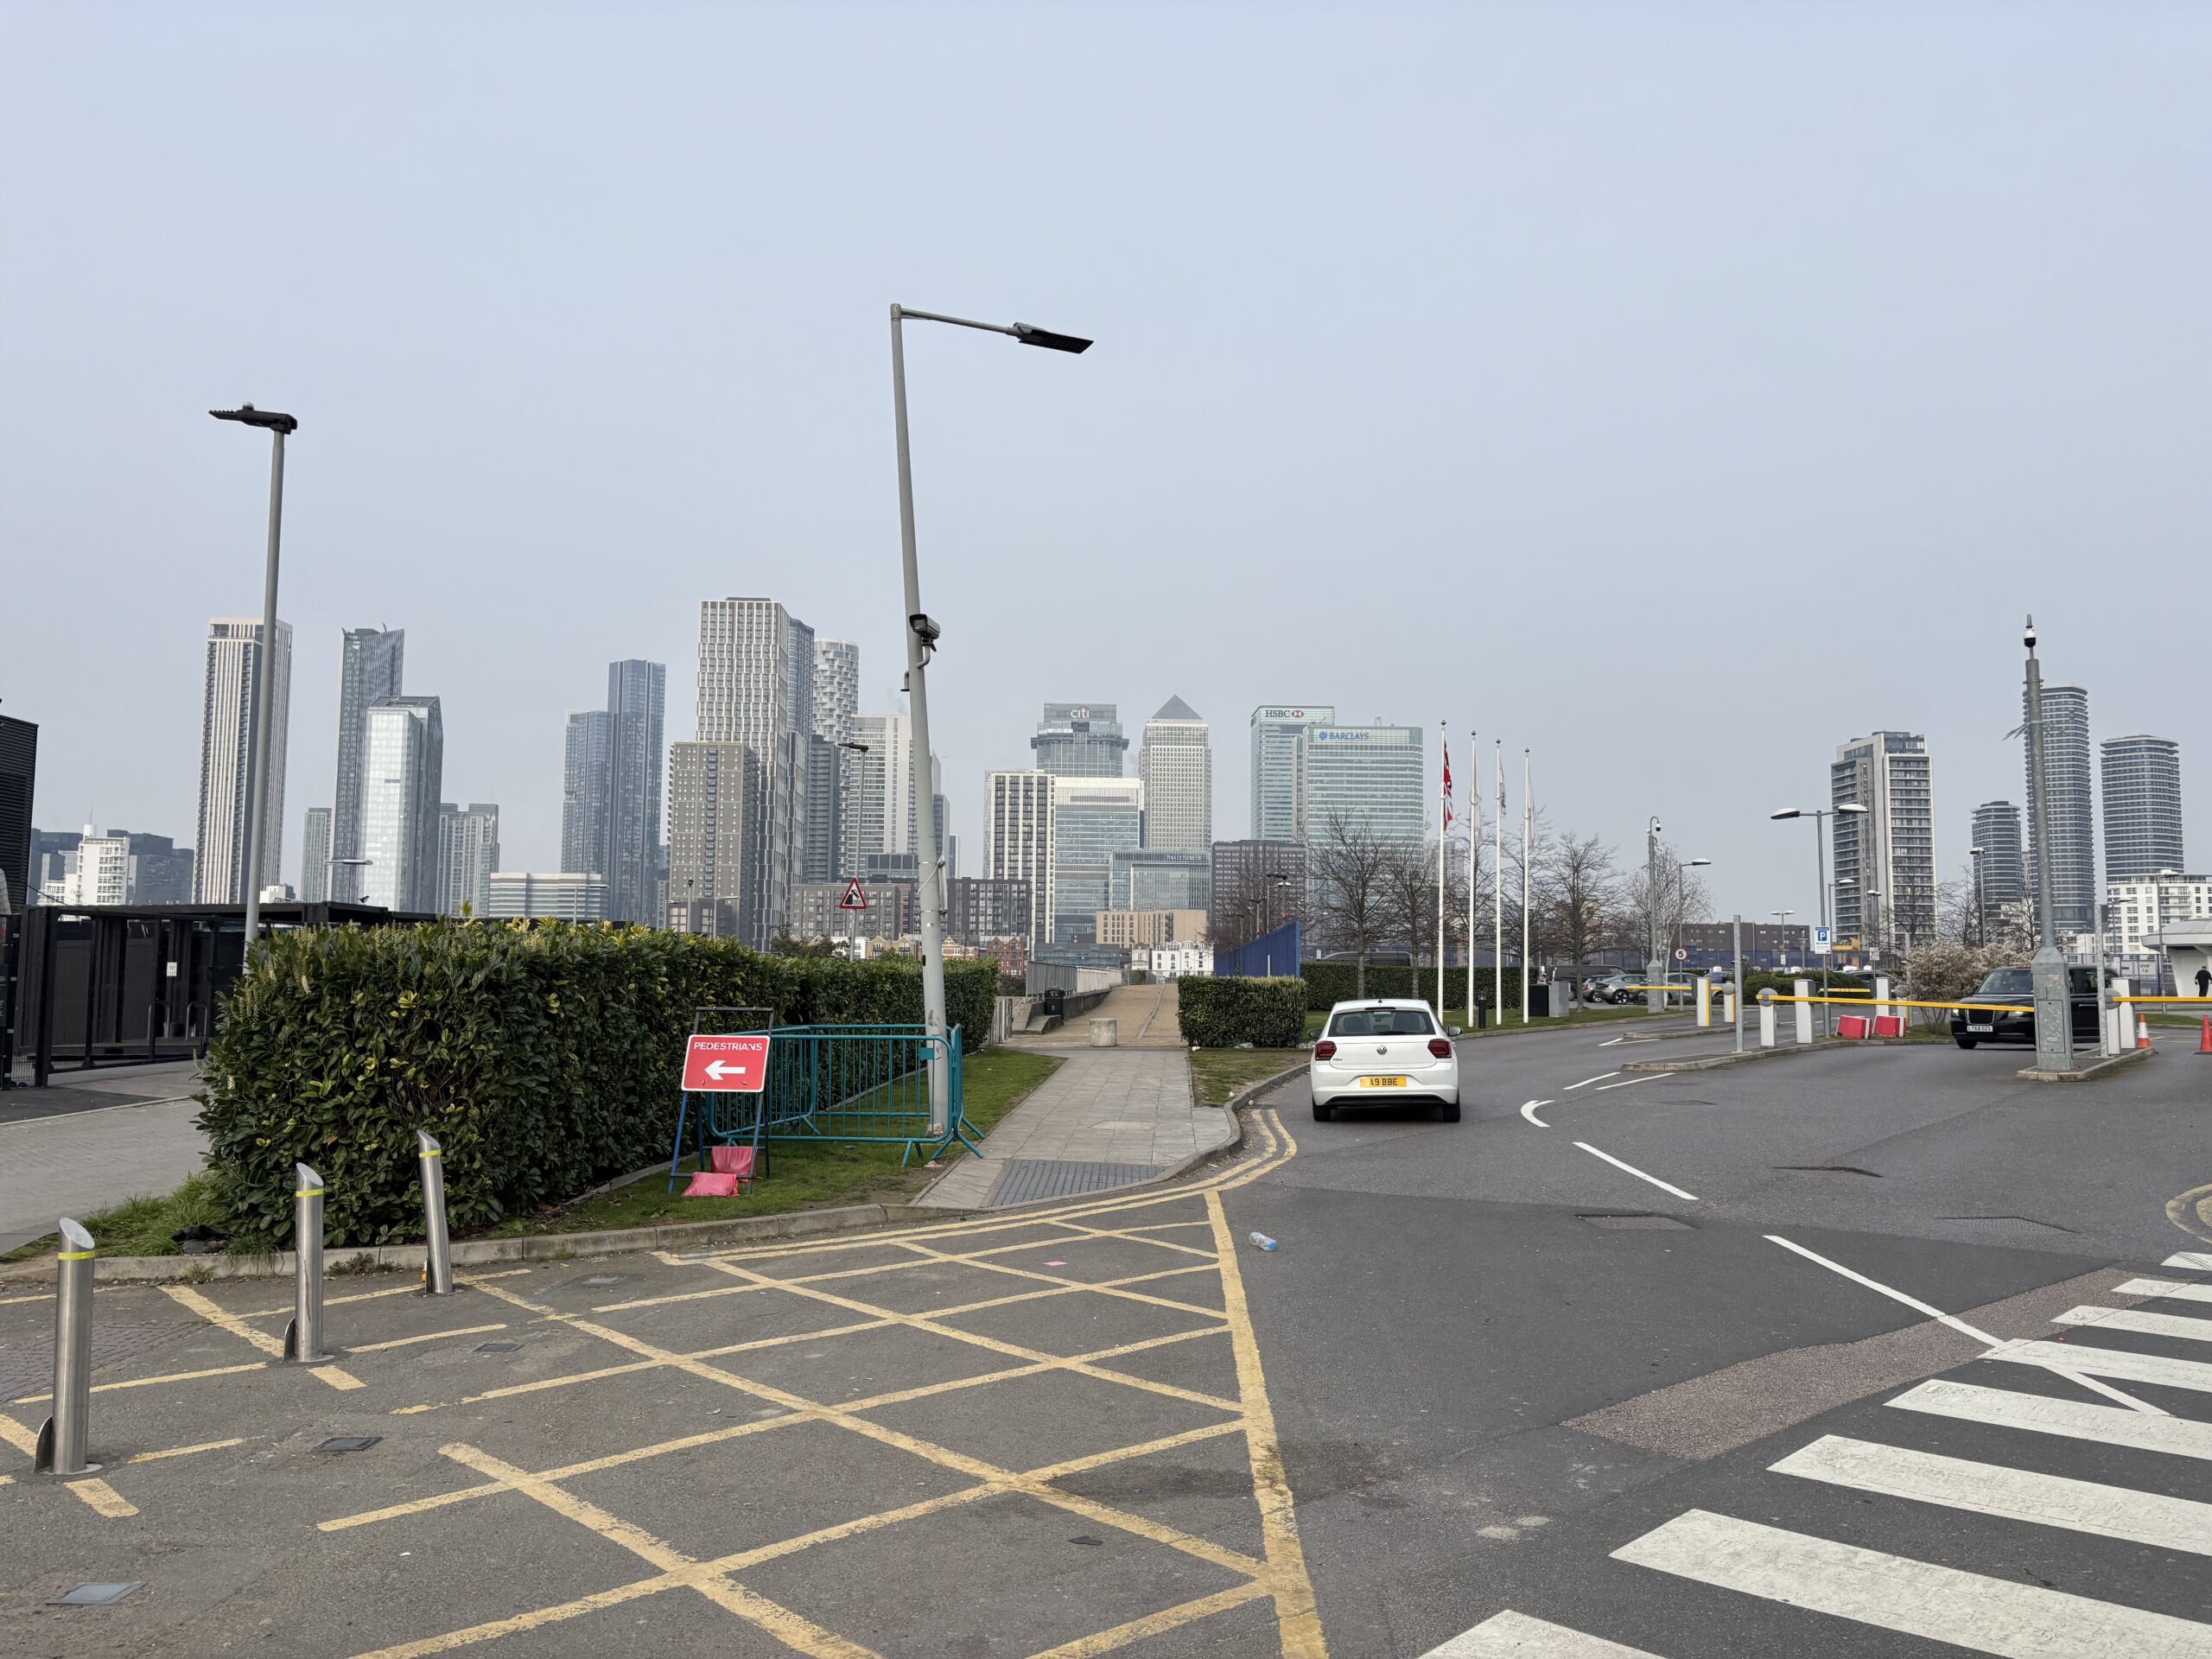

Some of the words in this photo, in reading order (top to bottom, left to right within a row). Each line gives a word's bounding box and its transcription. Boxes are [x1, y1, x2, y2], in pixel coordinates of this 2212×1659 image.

[1071, 707, 1090, 718] citi
[1265, 709, 1291, 718] HSBC
[1329, 732, 1370, 741] BARCLAYS
[1819, 931, 1826, 941] P
[694, 1042, 763, 1052] PEDESTRIANS
[1370, 1077, 1380, 1086] A9
[1382, 1077, 1398, 1086] BBE
